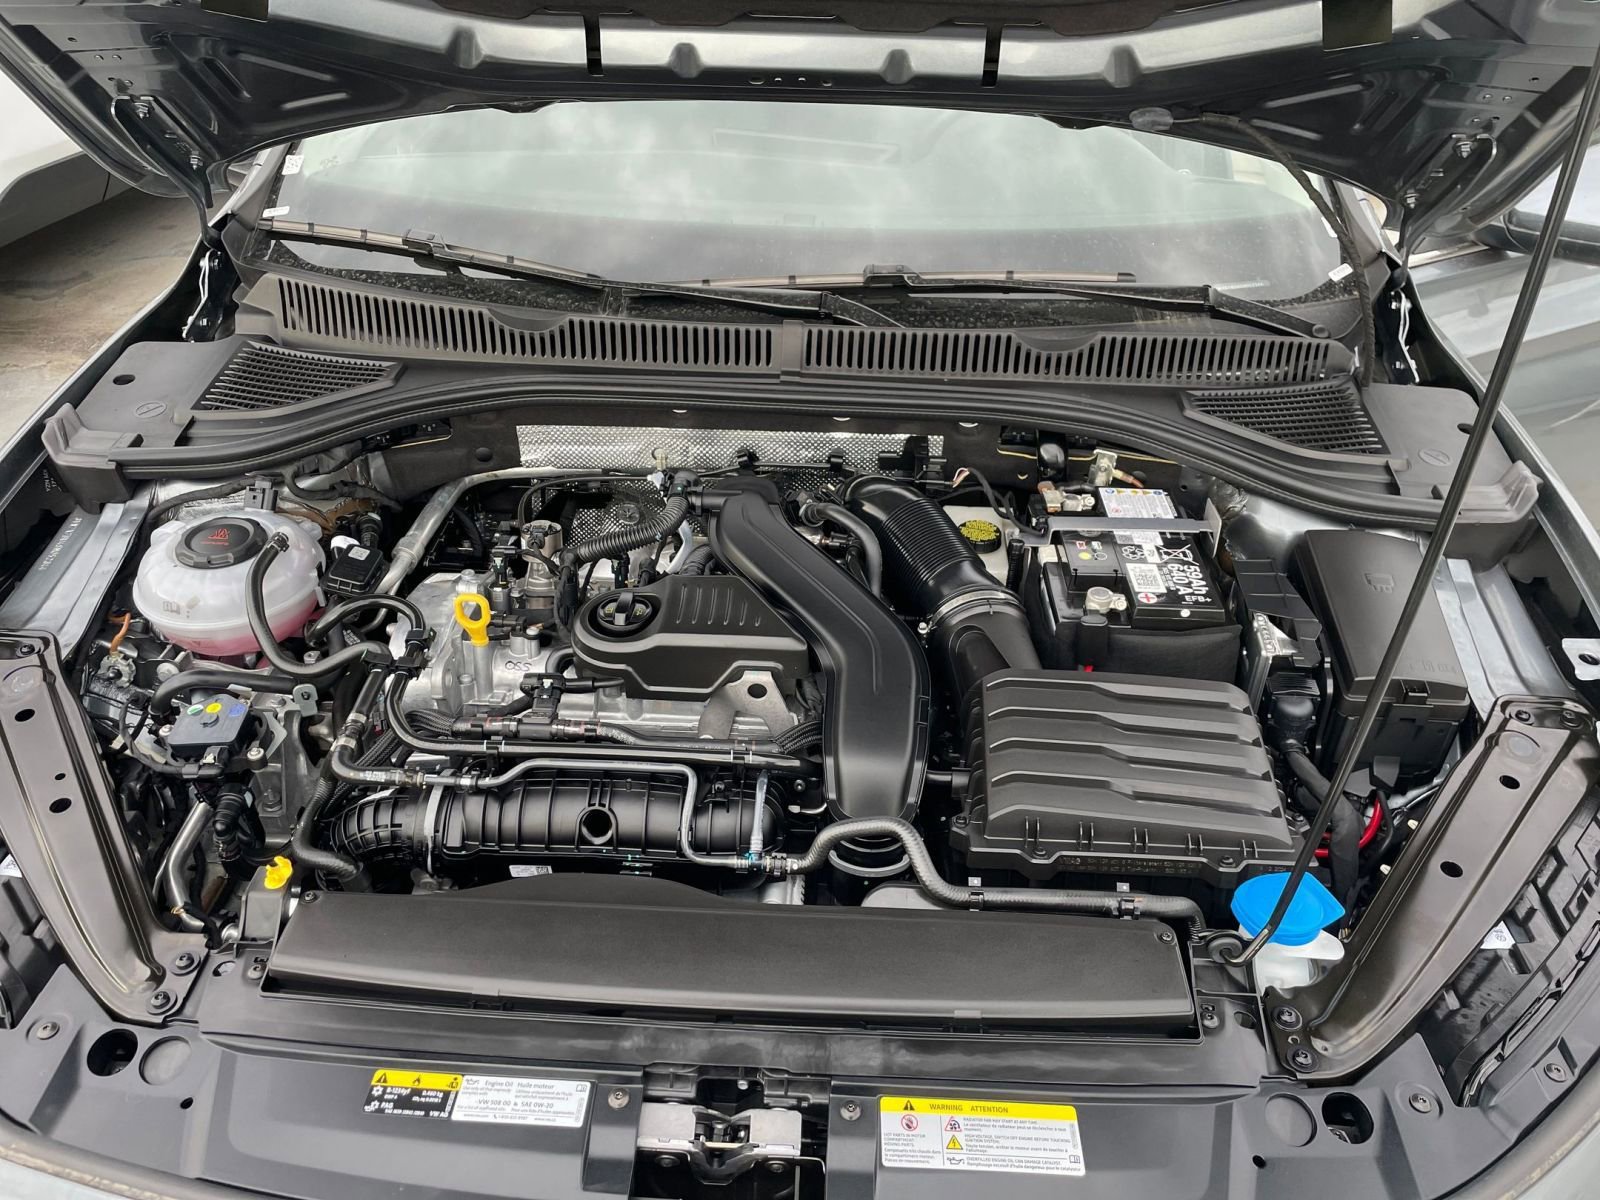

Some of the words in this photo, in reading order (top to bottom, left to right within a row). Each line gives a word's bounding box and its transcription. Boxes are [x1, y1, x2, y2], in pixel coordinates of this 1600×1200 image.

[1167, 563, 1189, 584] 640
[1183, 565, 1209, 594] 59Ah
[1175, 585, 1194, 595] A
[485, 1080, 504, 1088] Engine
